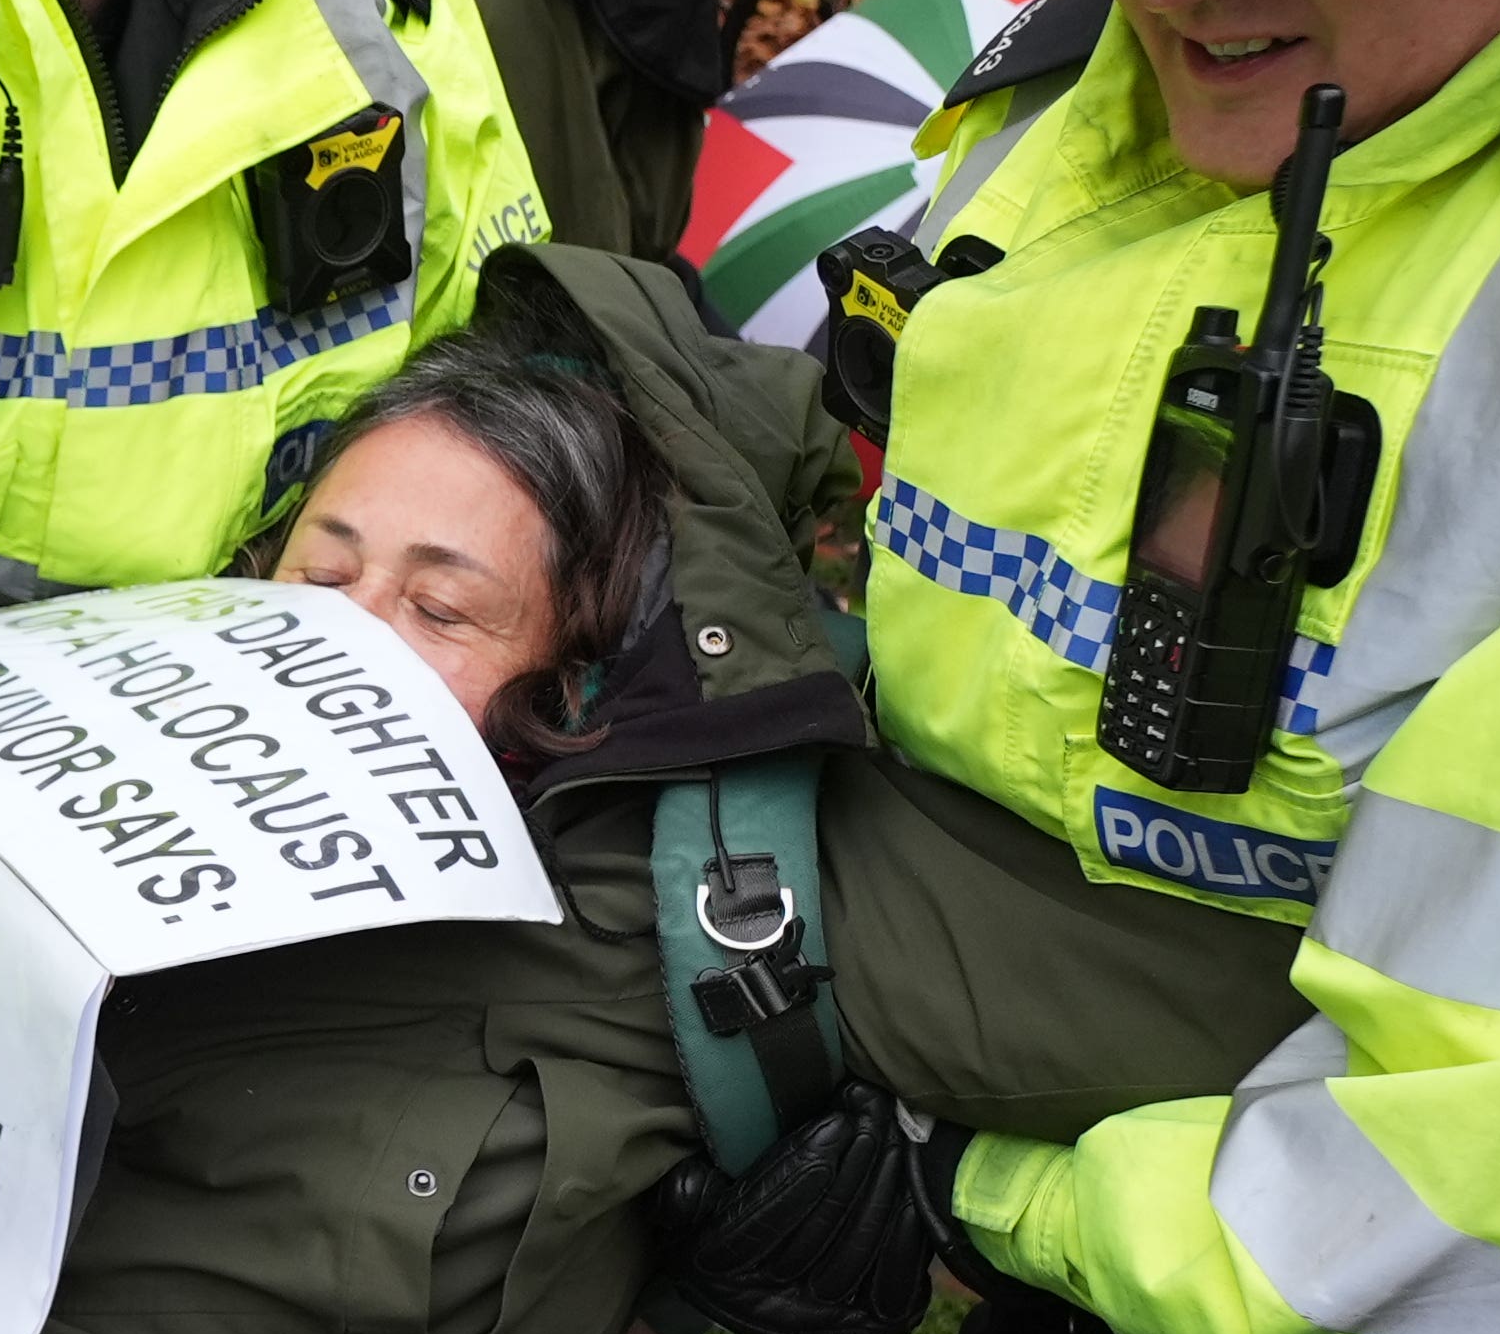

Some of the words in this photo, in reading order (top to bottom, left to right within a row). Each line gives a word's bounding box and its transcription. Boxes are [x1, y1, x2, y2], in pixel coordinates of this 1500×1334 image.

[342, 138, 373, 154] VIDEO
[352, 144, 384, 161] AUDIO
[78, 640, 406, 905] HOLOCAUST
[217, 611, 498, 870] DAUGHTER
[58, 777, 241, 924] SAYS:
